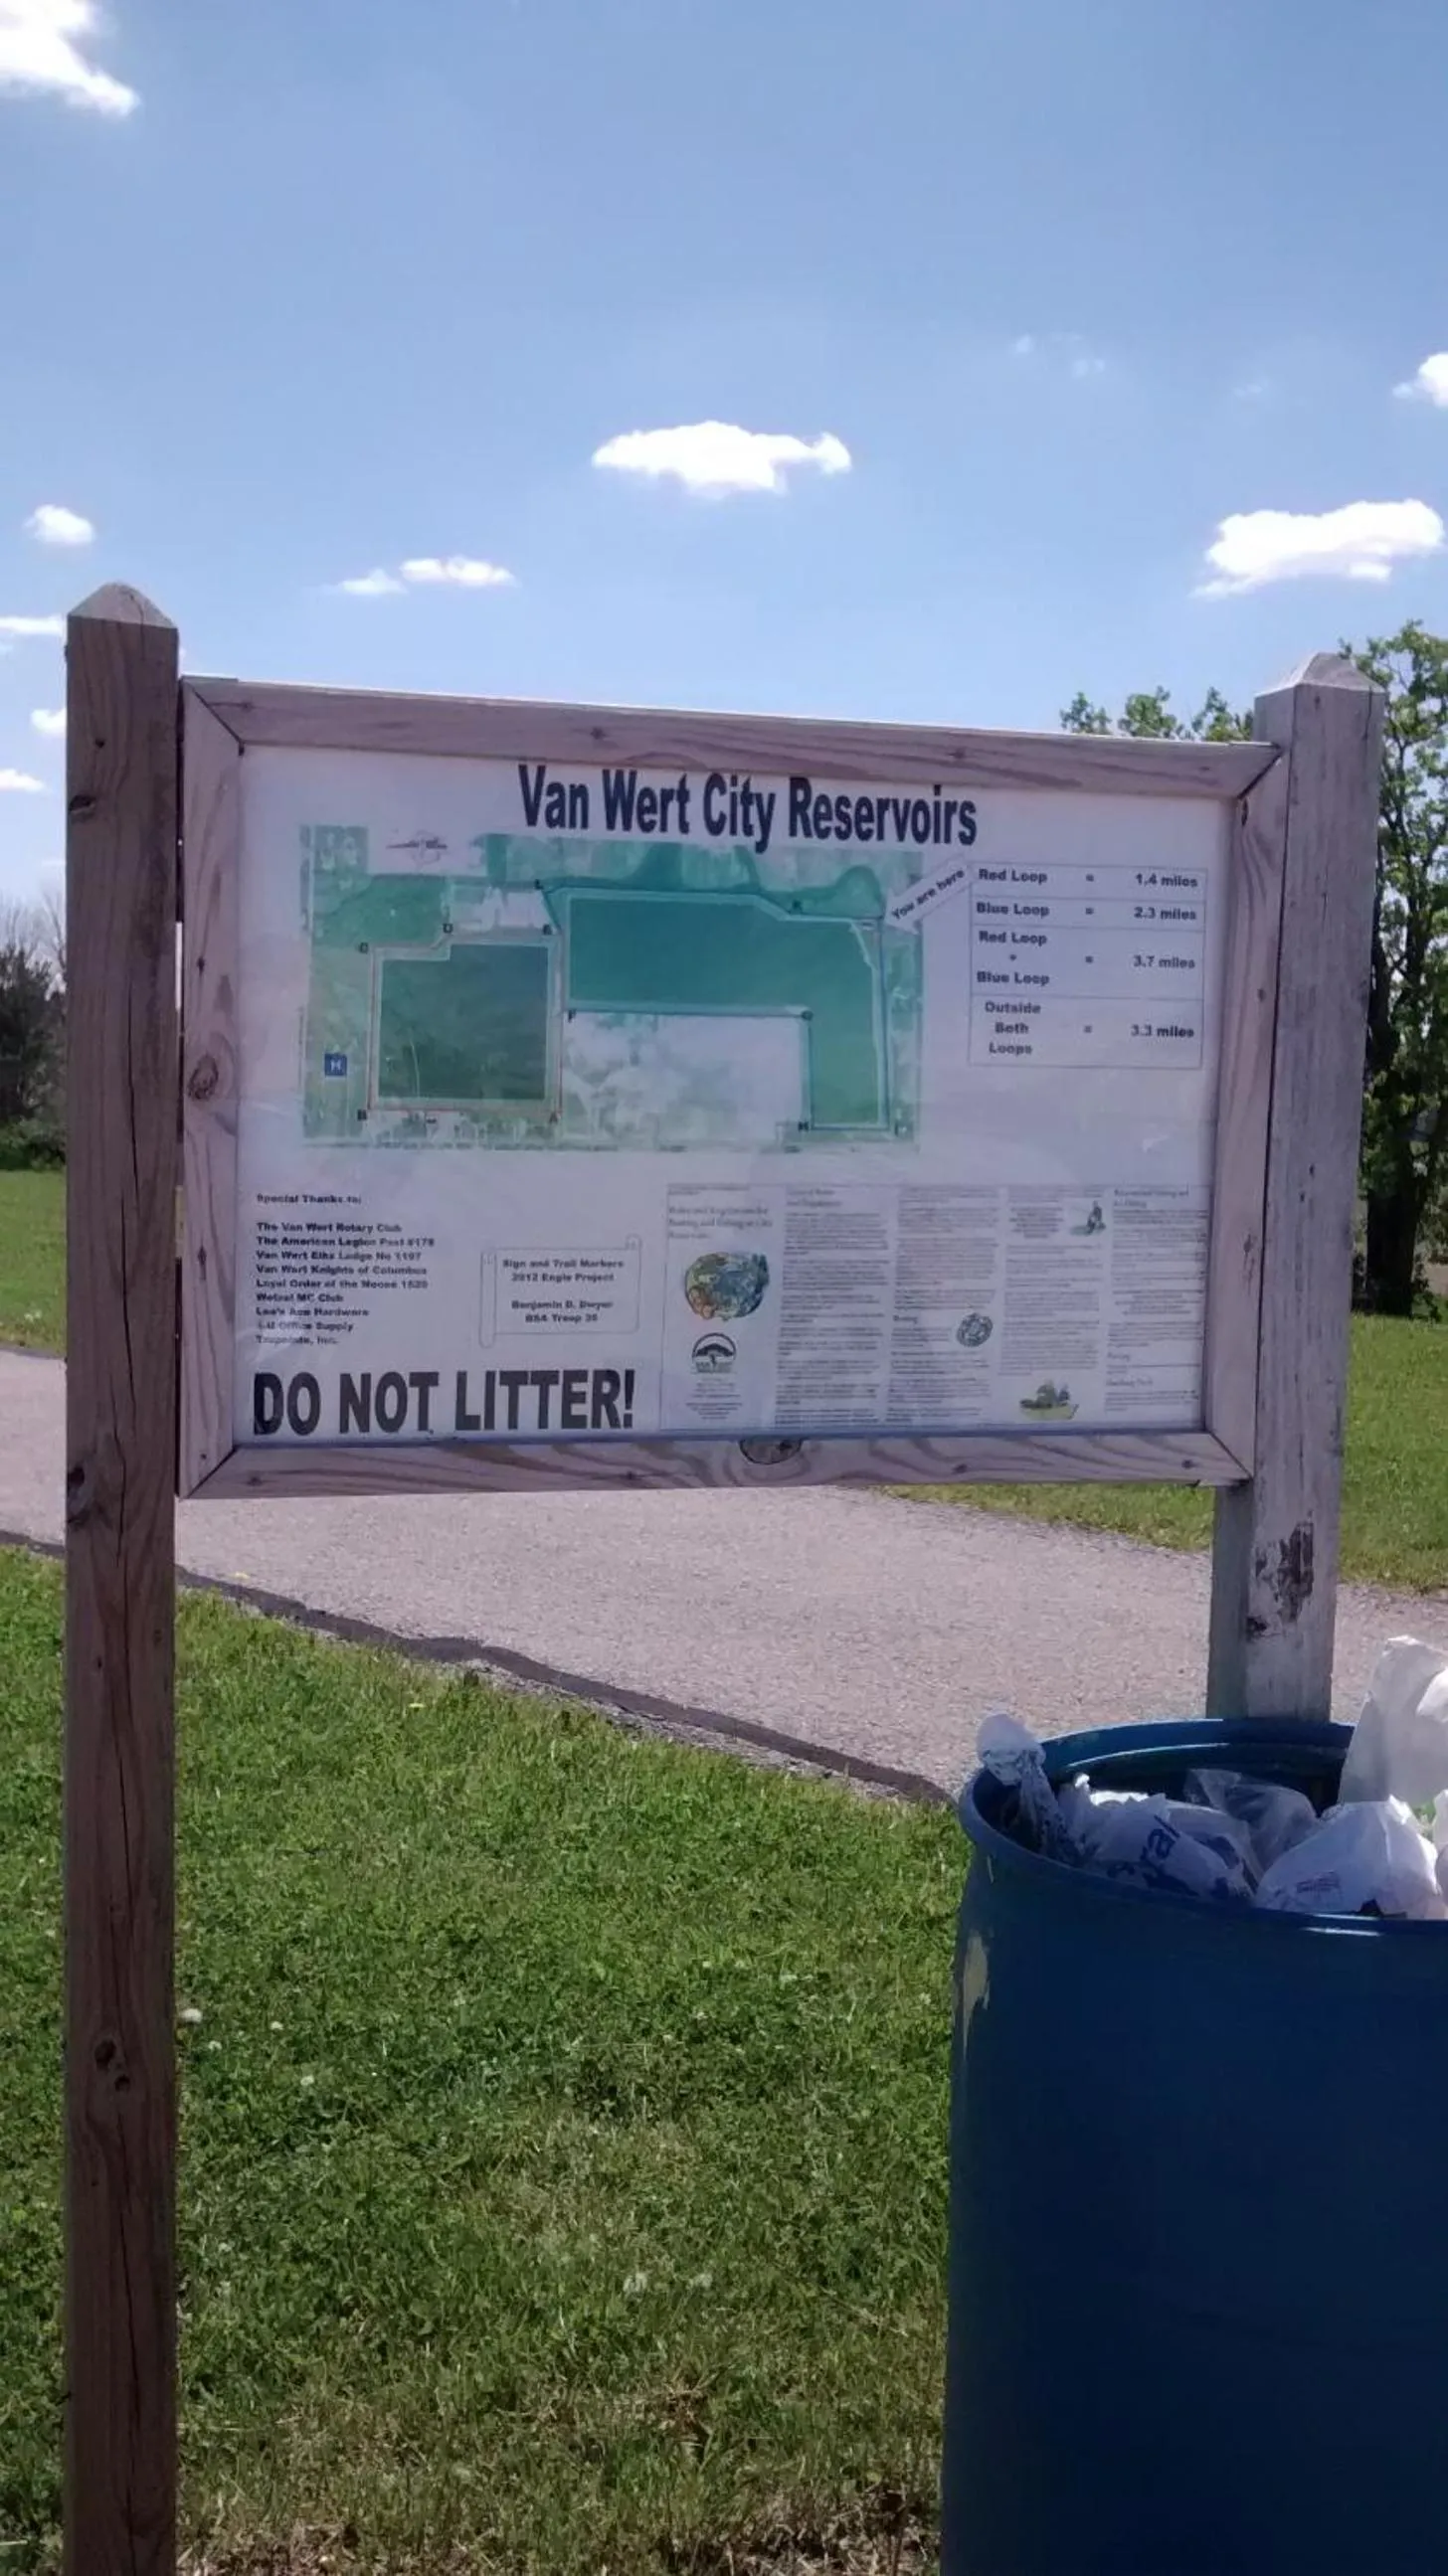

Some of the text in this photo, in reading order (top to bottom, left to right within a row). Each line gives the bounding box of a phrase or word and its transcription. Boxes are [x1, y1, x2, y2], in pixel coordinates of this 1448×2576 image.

[518, 764, 978, 854] Van Wert City Reservoirs
[979, 868, 1006, 881] Red
[1010, 870, 1047, 885] Loop
[1136, 874, 1158, 887] 1.4
[1161, 875, 1197, 888] miles
[891, 870, 965, 920] You are here
[977, 902, 1008, 916] Blue
[1013, 904, 1050, 918] Loop
[1134, 907, 1157, 920] 2.3
[1161, 908, 1196, 921] miles
[979, 931, 1047, 947] Red Loop
[1133, 954, 1155, 968] 3.7
[1159, 956, 1195, 969] miles
[977, 971, 1049, 986] Blue Loop
[985, 1001, 1041, 1014] Outside
[995, 1022, 1028, 1034] Both
[1131, 1024, 1153, 1037] 3.3
[1157, 1026, 1194, 1039] miles
[989, 1042, 1032, 1056] Loops
[302, 1194, 342, 1203] Thanks
[257, 1222, 278, 1231] The
[281, 1222, 302, 1232] Van
[336, 1223, 373, 1235] Rotary
[257, 1236, 278, 1246] The
[281, 1237, 335, 1246] American
[338, 1238, 377, 1249] Legion
[256, 1250, 277, 1260] Van
[256, 1264, 277, 1274] Van
[254, 1371, 321, 1436] DO
[339, 1371, 440, 1433] NOT
[455, 1369, 636, 1431] LITTER!
